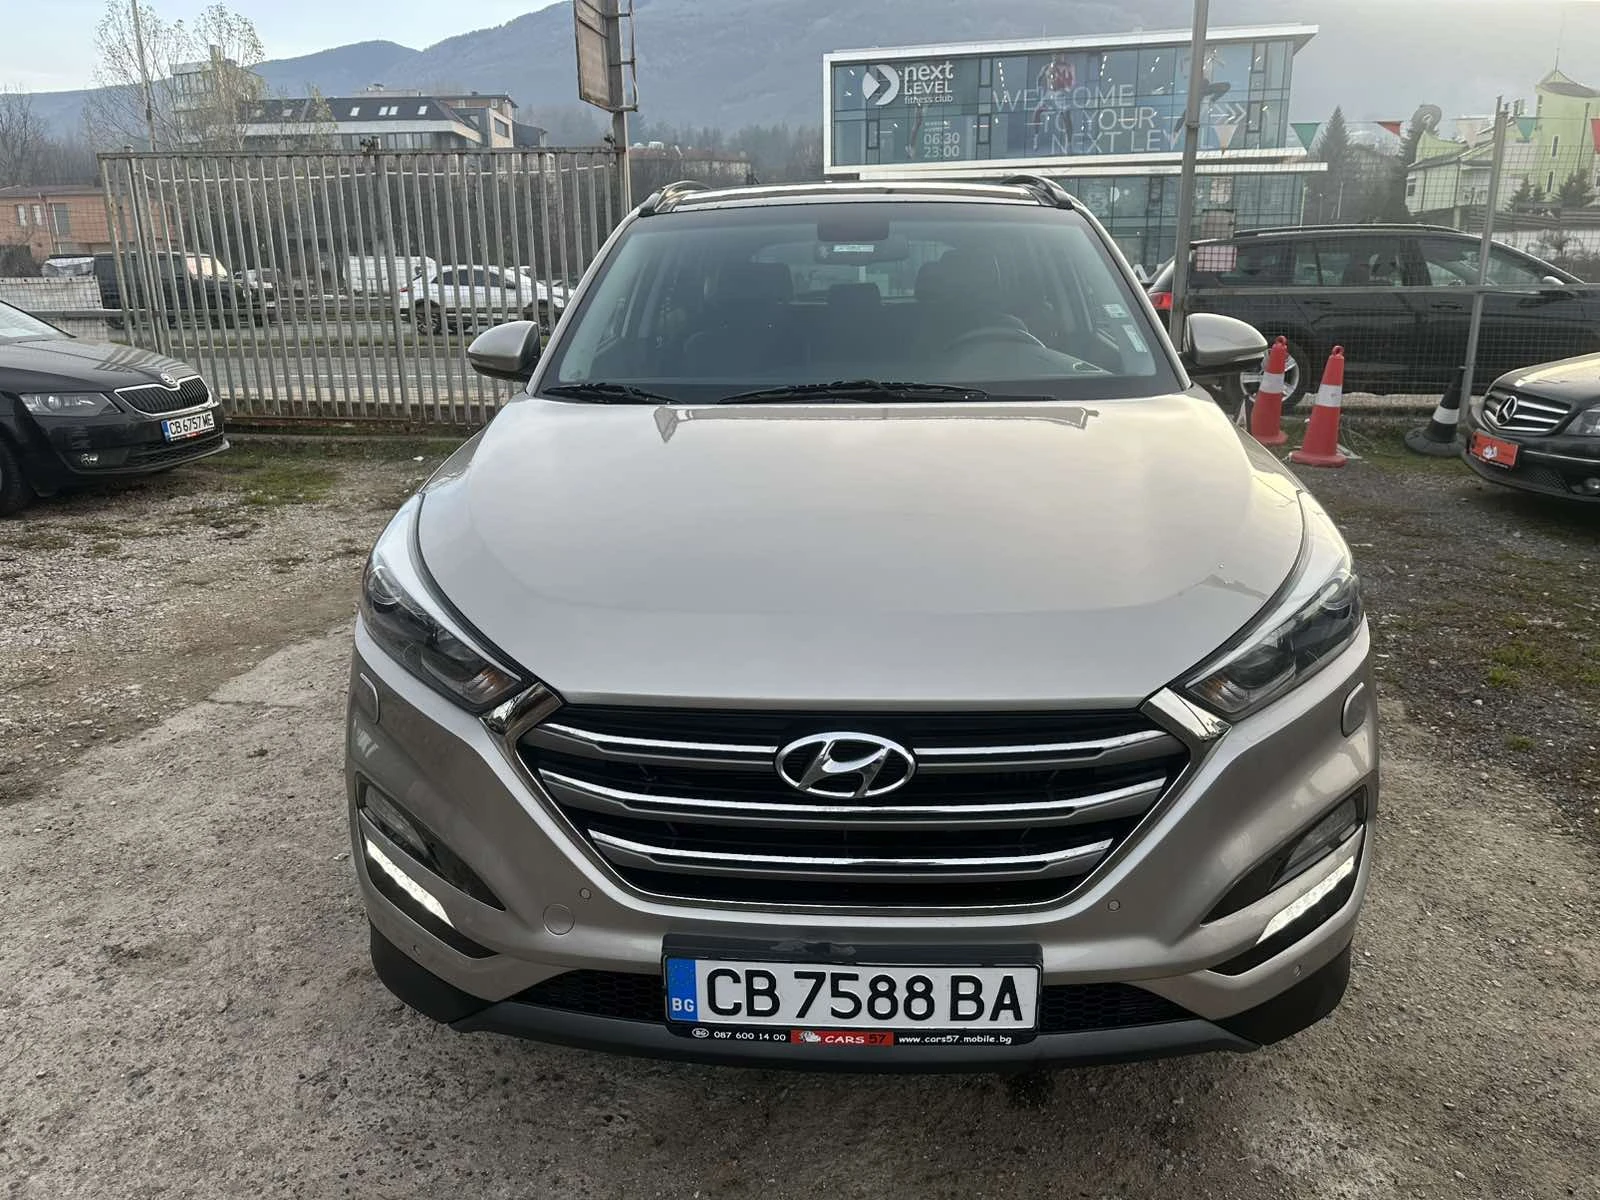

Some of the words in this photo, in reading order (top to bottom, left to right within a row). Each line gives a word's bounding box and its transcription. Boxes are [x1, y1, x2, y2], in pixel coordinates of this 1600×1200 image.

[904, 61, 954, 81] next
[904, 80, 953, 95] LEVEL
[935, 95, 953, 103] club
[1082, 106, 1156, 131] YOUR
[923, 132, 961, 145] 06:30
[1051, 130, 1122, 154] NEXT
[1130, 126, 1216, 152] LEVL
[923, 145, 960, 158] 23:00
[169, 420, 182, 435] CB
[183, 416, 201, 432] 6757
[707, 968, 781, 1017] CB
[793, 970, 936, 1021] 7588
[949, 974, 1023, 1021] BA
[672, 997, 695, 1012] BG
[714, 1031, 732, 1039] 087
[735, 1032, 755, 1040] 600
[773, 1033, 786, 1041] 00
[825, 1035, 865, 1044] CARS
[868, 1032, 887, 1044] 57
[899, 1034, 1012, 1045] www.cars57.mobile.bg
